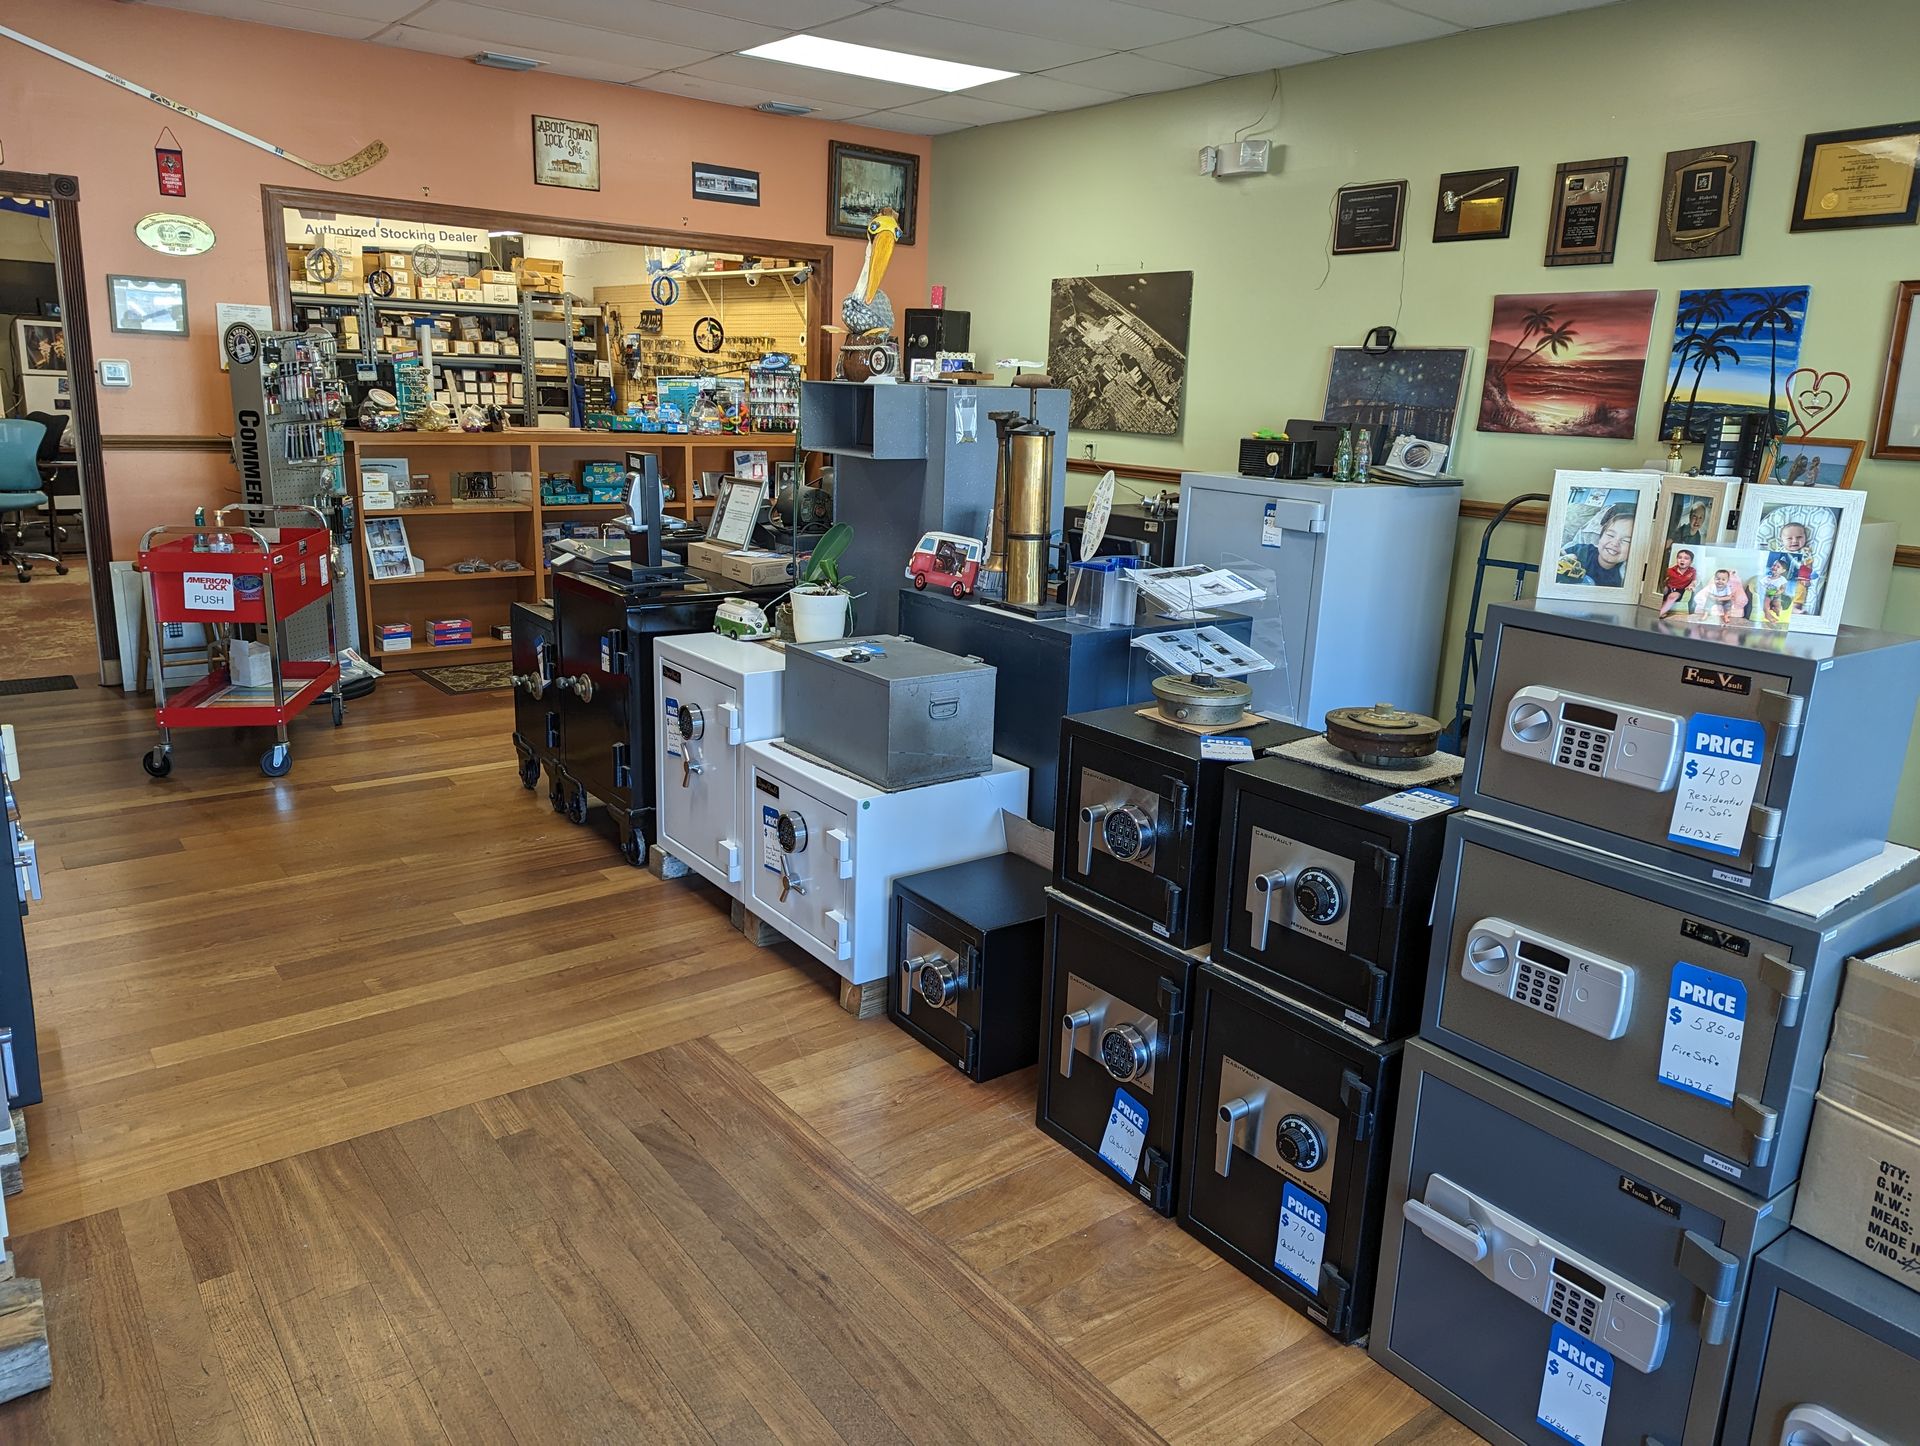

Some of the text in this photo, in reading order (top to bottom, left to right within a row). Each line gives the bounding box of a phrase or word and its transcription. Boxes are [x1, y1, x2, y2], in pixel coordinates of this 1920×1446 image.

[537, 121, 592, 142] ABOUT TOWN
[544, 133, 564, 149] LOCK
[305, 223, 478, 243] Authorized Stocking Dealer
[186, 576, 231, 586] AMERICAN
[203, 583, 228, 591] LOCK
[194, 595, 224, 605] PUSH
[1717, 671, 1744, 690] Vault
[1695, 732, 1755, 759] PRICE
[1702, 766, 1742, 786] 480
[1411, 791, 1456, 806] PRICE
[1684, 802, 1704, 813] Fire
[1687, 788, 1744, 807] Residential
[1317, 931, 1333, 941] Safe
[1334, 938, 1346, 947] Co.
[1679, 980, 1737, 1014] PRICE
[1690, 1017, 1741, 1041] 585.00
[1117, 1099, 1144, 1129] PRICE
[1880, 1160, 1910, 1184] QTY:
[1302, 1179, 1318, 1193] Safe
[1621, 1177, 1675, 1214] Flame Vault
[1876, 1176, 1912, 1202] G.W.:
[1287, 1195, 1321, 1227] PRICE
[1874, 1190, 1910, 1217] N.W.:
[1870, 1205, 1914, 1235] MEAS:
[1867, 1221, 1908, 1250] MADE
[1557, 1337, 1605, 1379] PRICE
